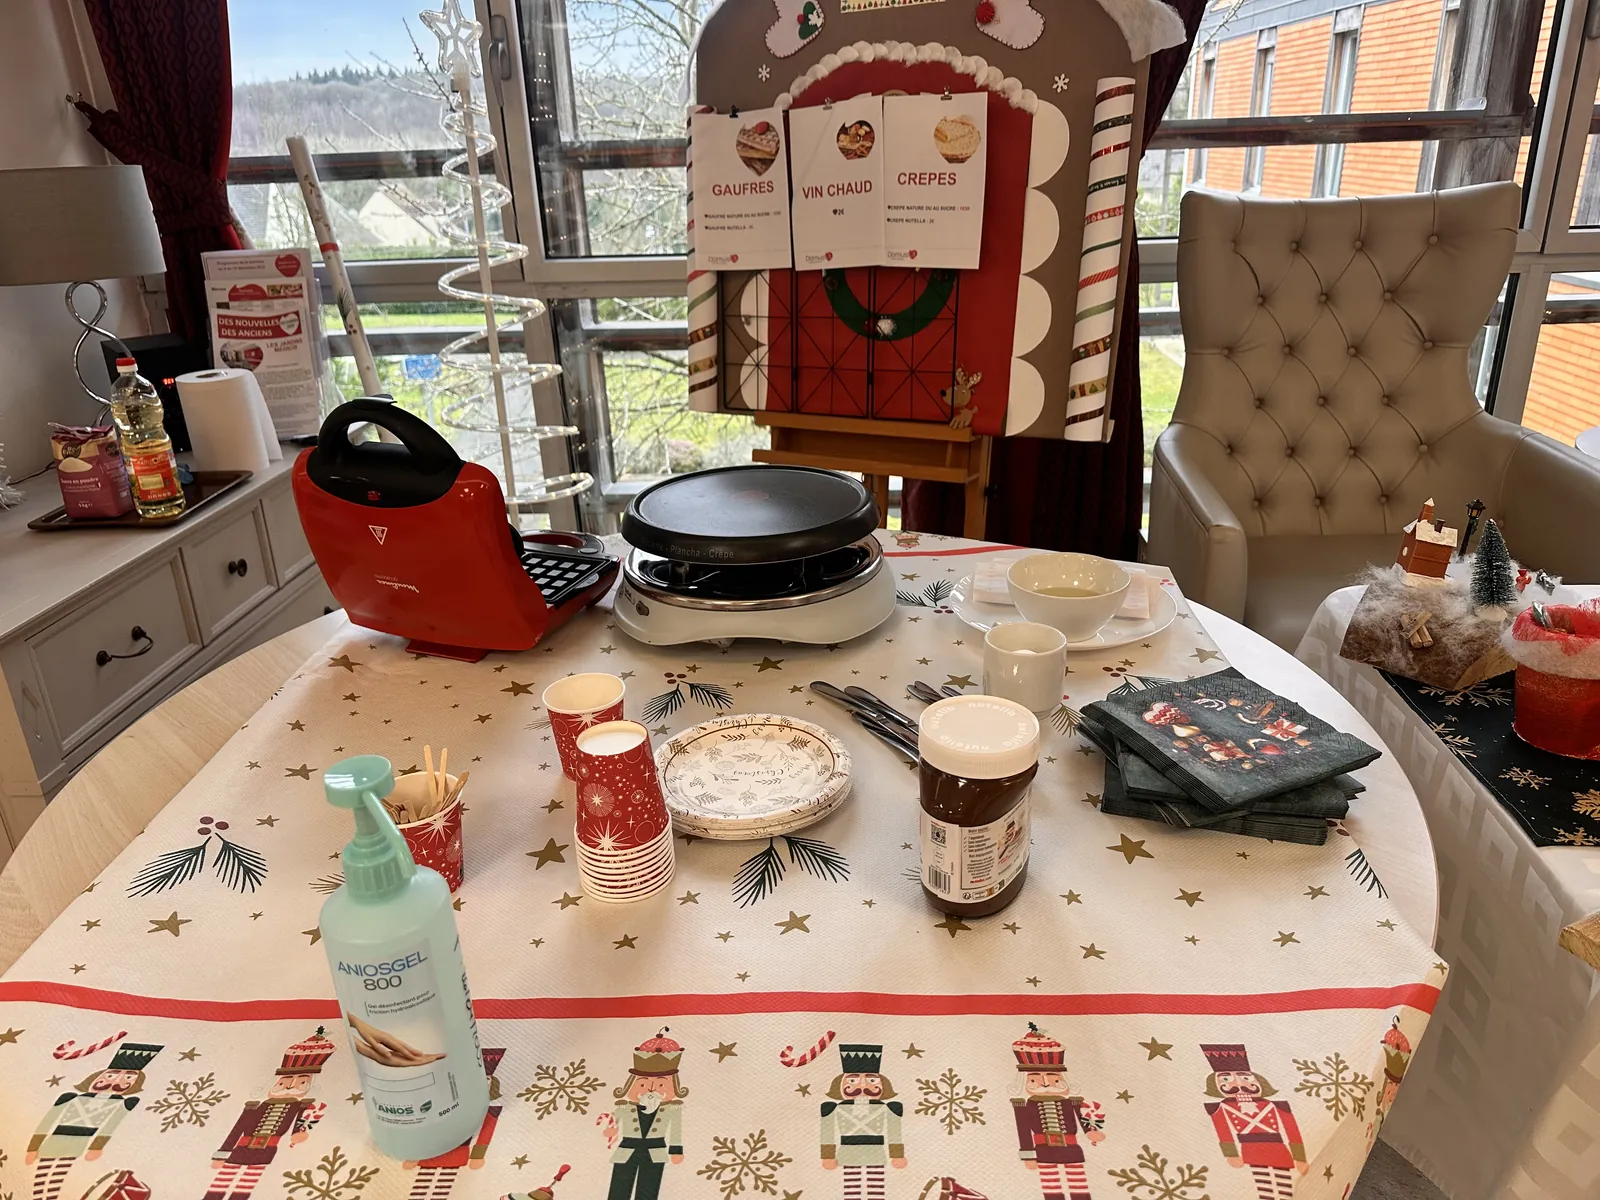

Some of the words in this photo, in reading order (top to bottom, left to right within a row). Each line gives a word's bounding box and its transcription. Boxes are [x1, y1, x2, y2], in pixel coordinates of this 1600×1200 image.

[897, 172, 957, 186] CREPES
[712, 180, 774, 196] GAUFRES
[802, 184, 823, 199] VIN
[827, 180, 873, 197] CHAUD
[218, 318, 234, 326] DES
[235, 318, 280, 327] NOUVELLES
[221, 328, 237, 336] DES
[238, 328, 273, 337] ANCIENS
[670, 545, 700, 557] Plancha
[968, 702, 1017, 717] nutella
[338, 951, 428, 977] ANIOSGEL
[363, 975, 402, 991] 800
[378, 1104, 414, 1115] ANIOS
[438, 1107, 451, 1117] 500
[451, 1102, 460, 1111] ml
